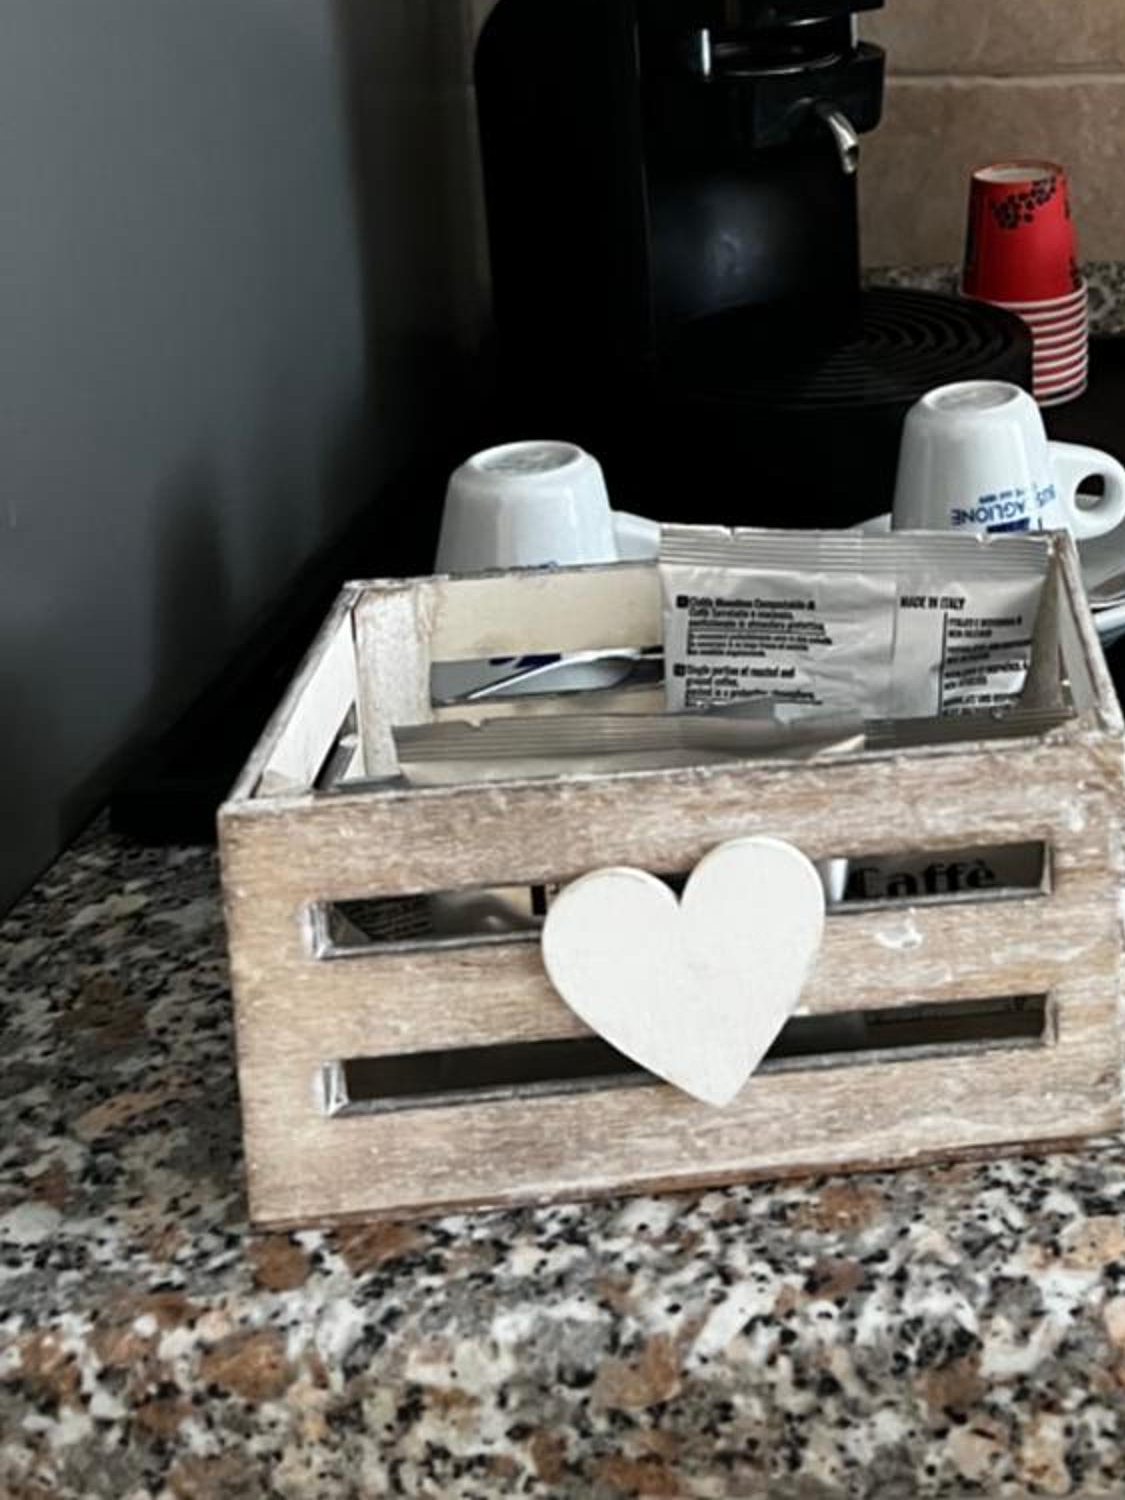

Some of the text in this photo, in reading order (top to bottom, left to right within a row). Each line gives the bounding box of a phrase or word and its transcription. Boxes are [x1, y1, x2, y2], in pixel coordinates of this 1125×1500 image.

[900, 596, 966, 610] MADE IN ITALY
[849, 858, 996, 900] Caffè
